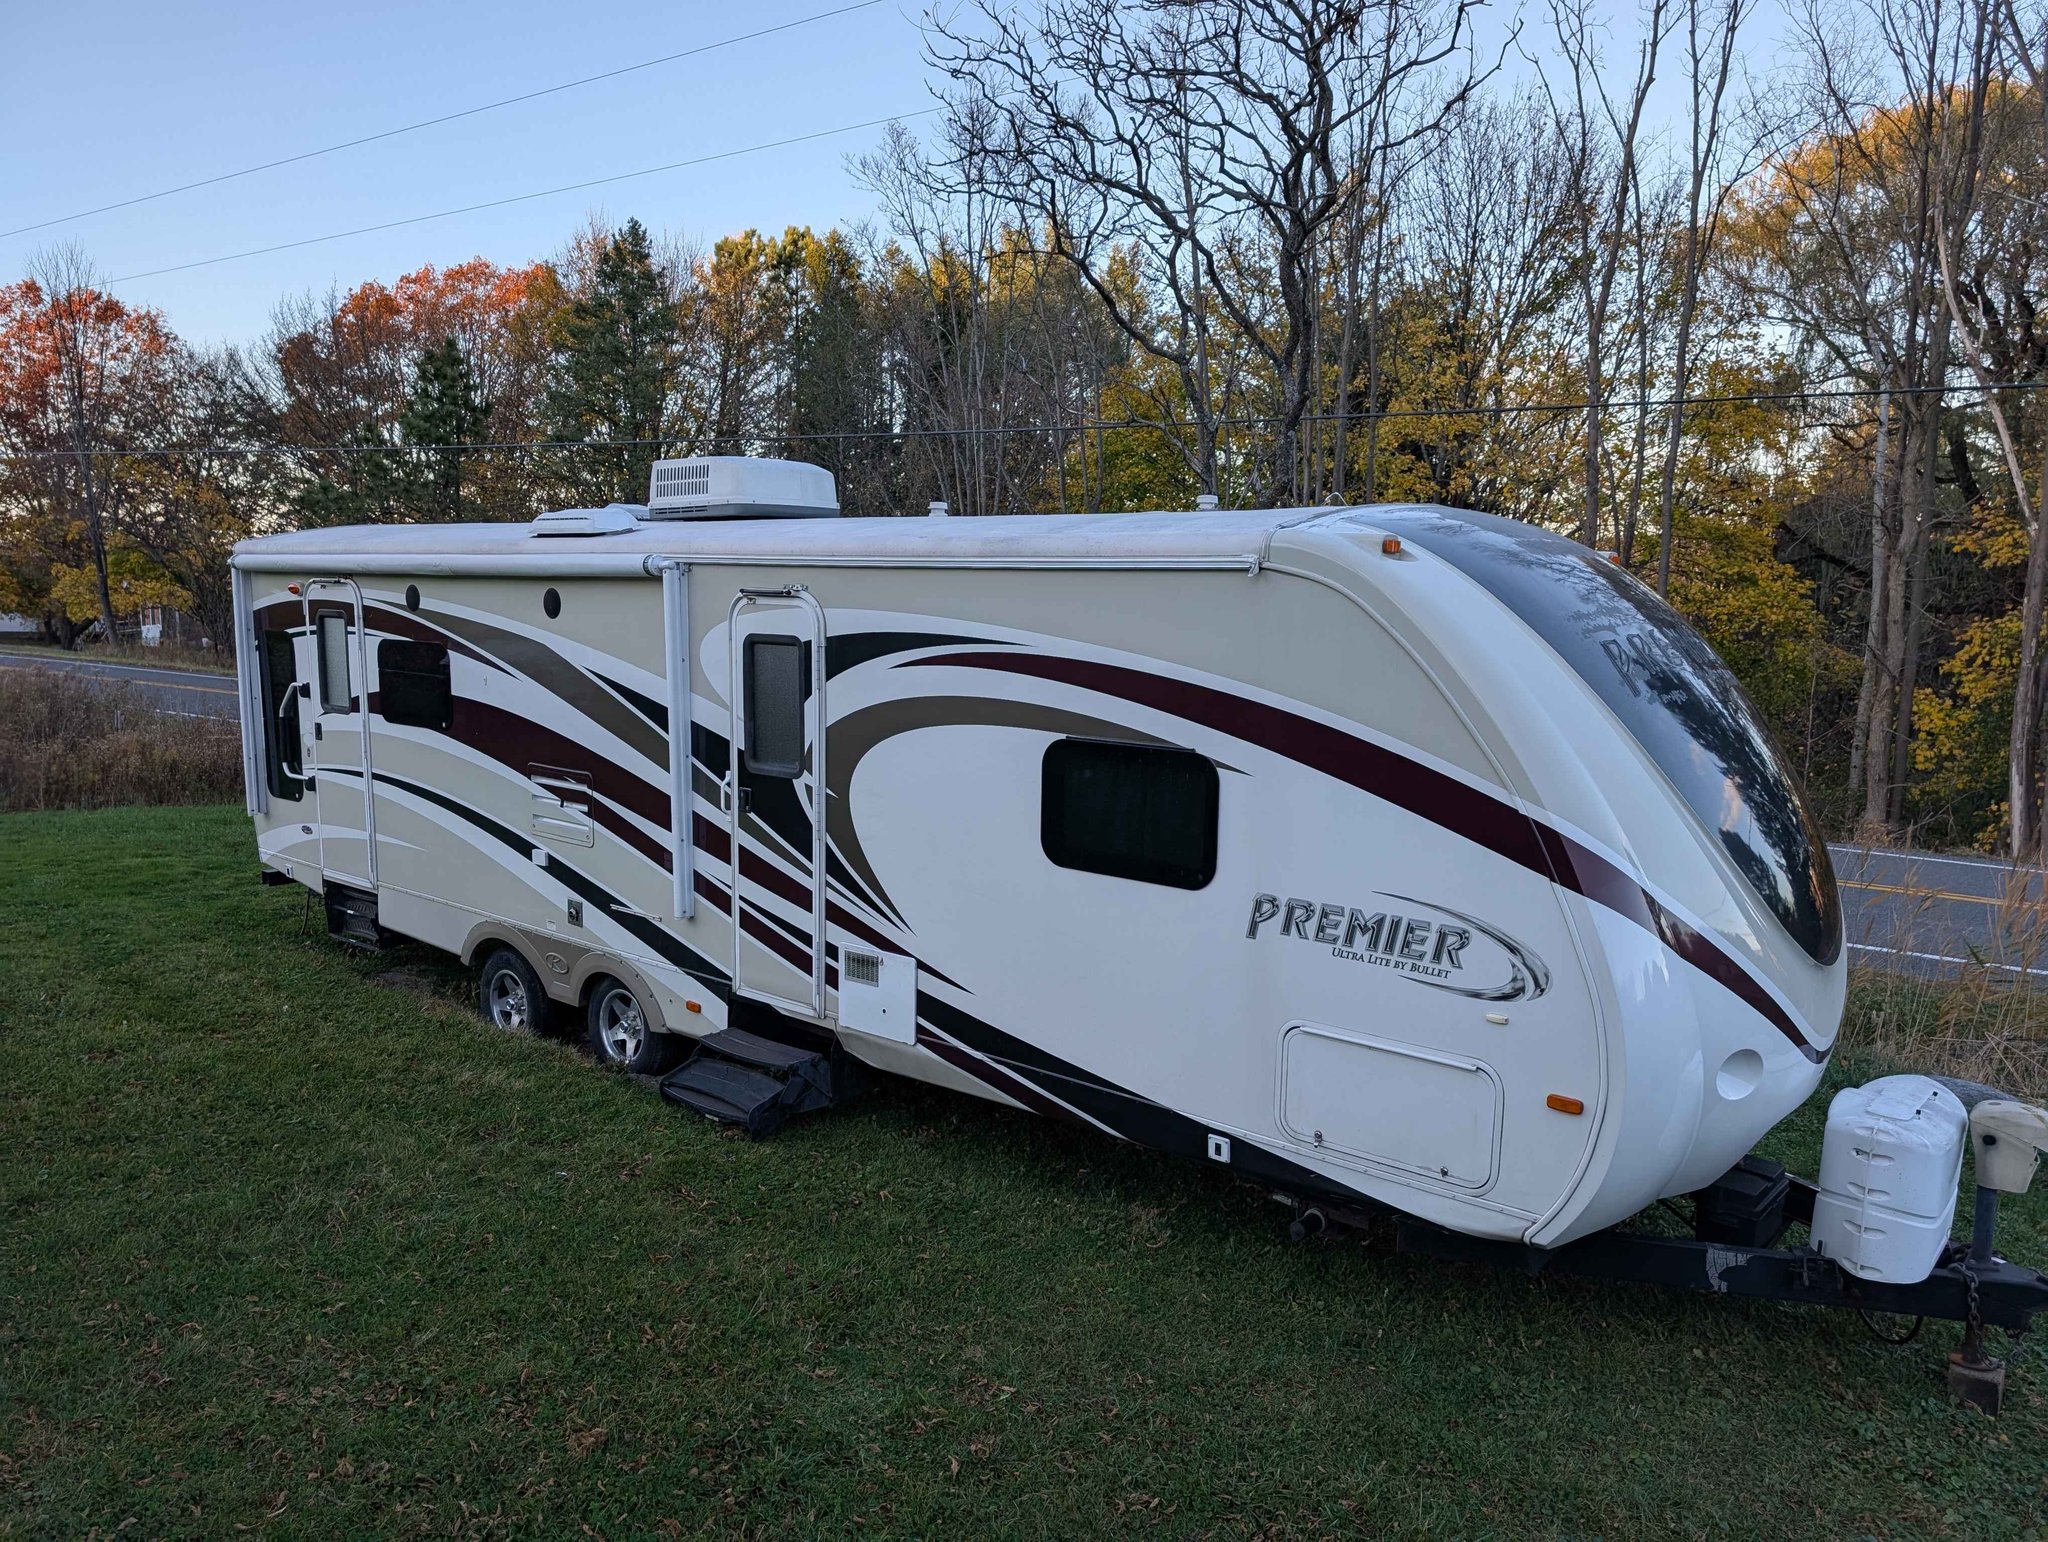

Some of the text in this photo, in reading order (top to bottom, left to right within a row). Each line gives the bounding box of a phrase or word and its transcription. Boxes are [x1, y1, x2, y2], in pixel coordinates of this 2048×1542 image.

[1246, 893, 1471, 970] PREMIER
[1331, 947, 1452, 980] ULTRA LITE BY BULLET
